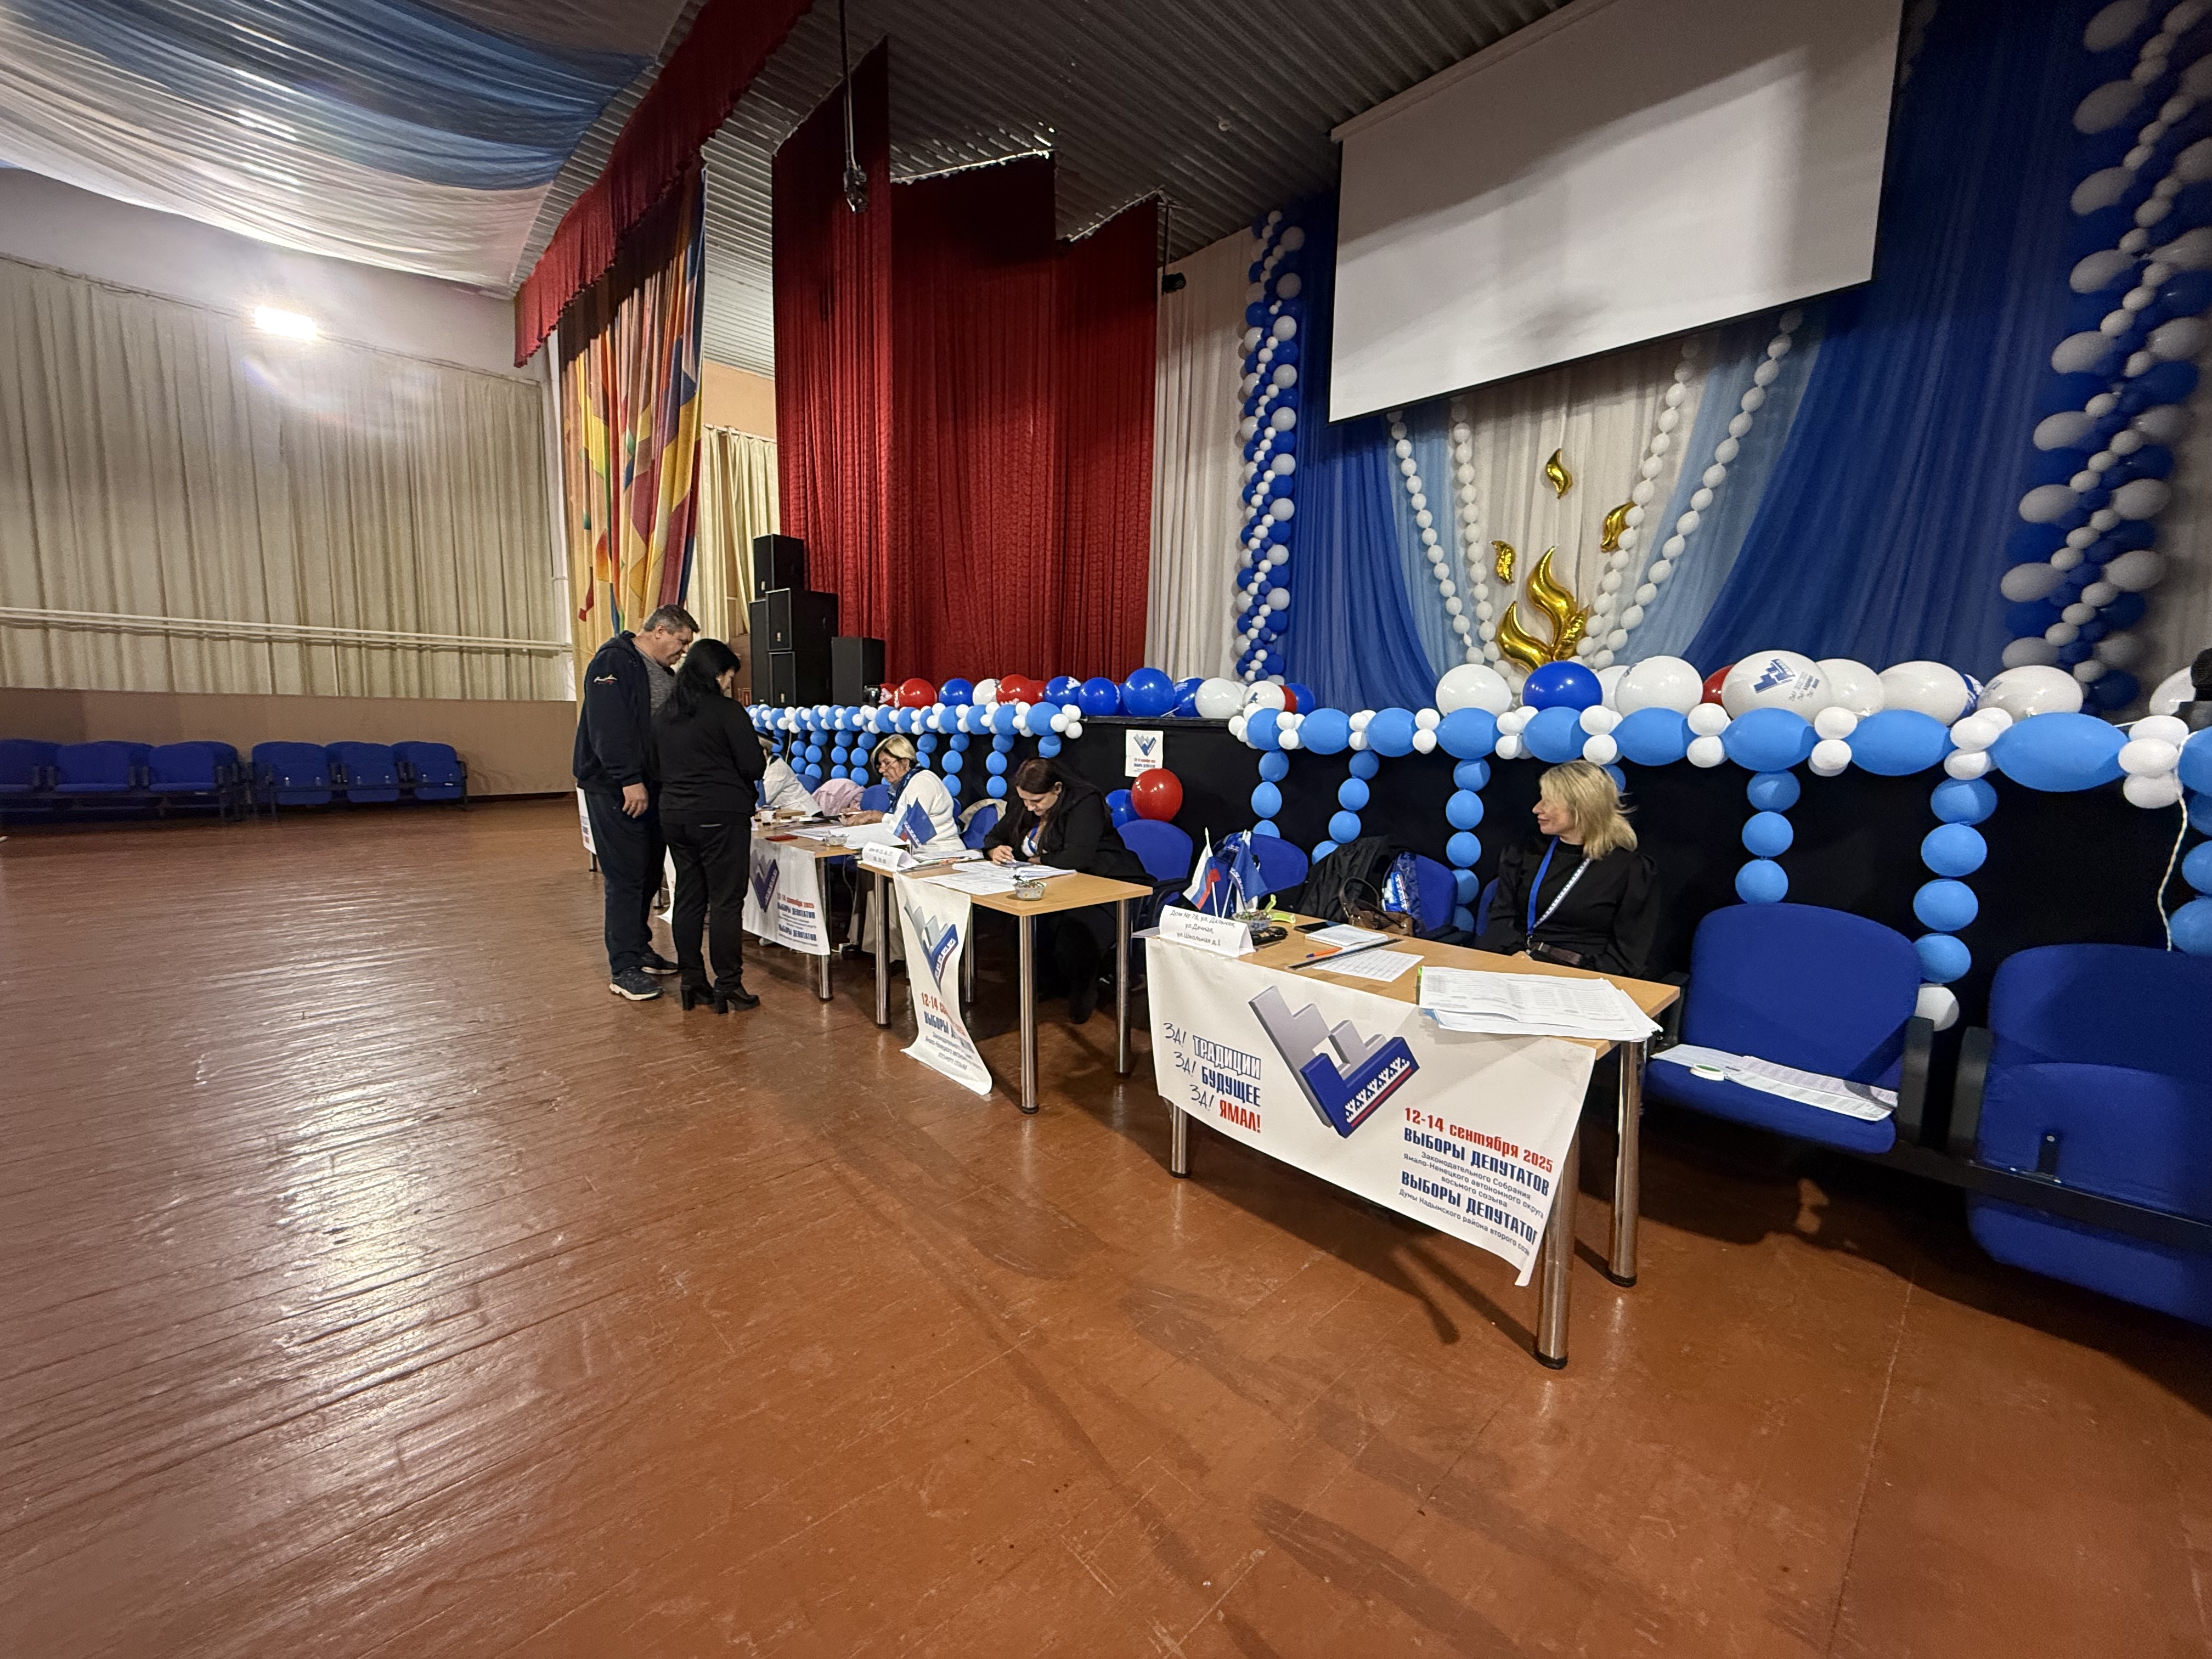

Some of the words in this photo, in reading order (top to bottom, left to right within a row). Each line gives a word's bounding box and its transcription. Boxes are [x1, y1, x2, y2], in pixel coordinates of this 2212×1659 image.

[922, 992, 938, 1011] 12-14
[924, 1011, 949, 1034] ВЫБОРЫ
[1164, 1023, 1187, 1047] ЗА!
[1193, 1035, 1261, 1080] ТРАДИЦИИ
[1173, 1051, 1197, 1077] ЗА!
[1201, 1065, 1261, 1107] БУДУЩЕЕ
[1189, 1084, 1215, 1111] ЗА!
[1220, 1099, 1261, 1133] ЯМАЛ!
[1404, 1127, 1465, 1161] ВЫБОРЫ
[1470, 1150, 1550, 1197] ДЕПУТАТОВ
[1405, 1108, 1444, 1132] 12-14
[1449, 1124, 1519, 1158] сентября
[1523, 1149, 1553, 1173] 2025
[1401, 1170, 1461, 1207] ВЫБОРЫ
[1403, 1153, 1469, 1183] Ямало-Ненецкого
[1471, 1180, 1521, 1205] автономного
[1522, 1201, 1544, 1219] округа
[1421, 1151, 1491, 1183] Законодательного
[1493, 1177, 1531, 1200] Собрания
[1441, 1176, 1476, 1194] восьмого
[1479, 1190, 1508, 1207] созыва
[1399, 1188, 1418, 1201] Думы
[1419, 1197, 1462, 1221] Надымского
[1462, 1215, 1488, 1232] района
[1490, 1228, 1517, 1246] второго
